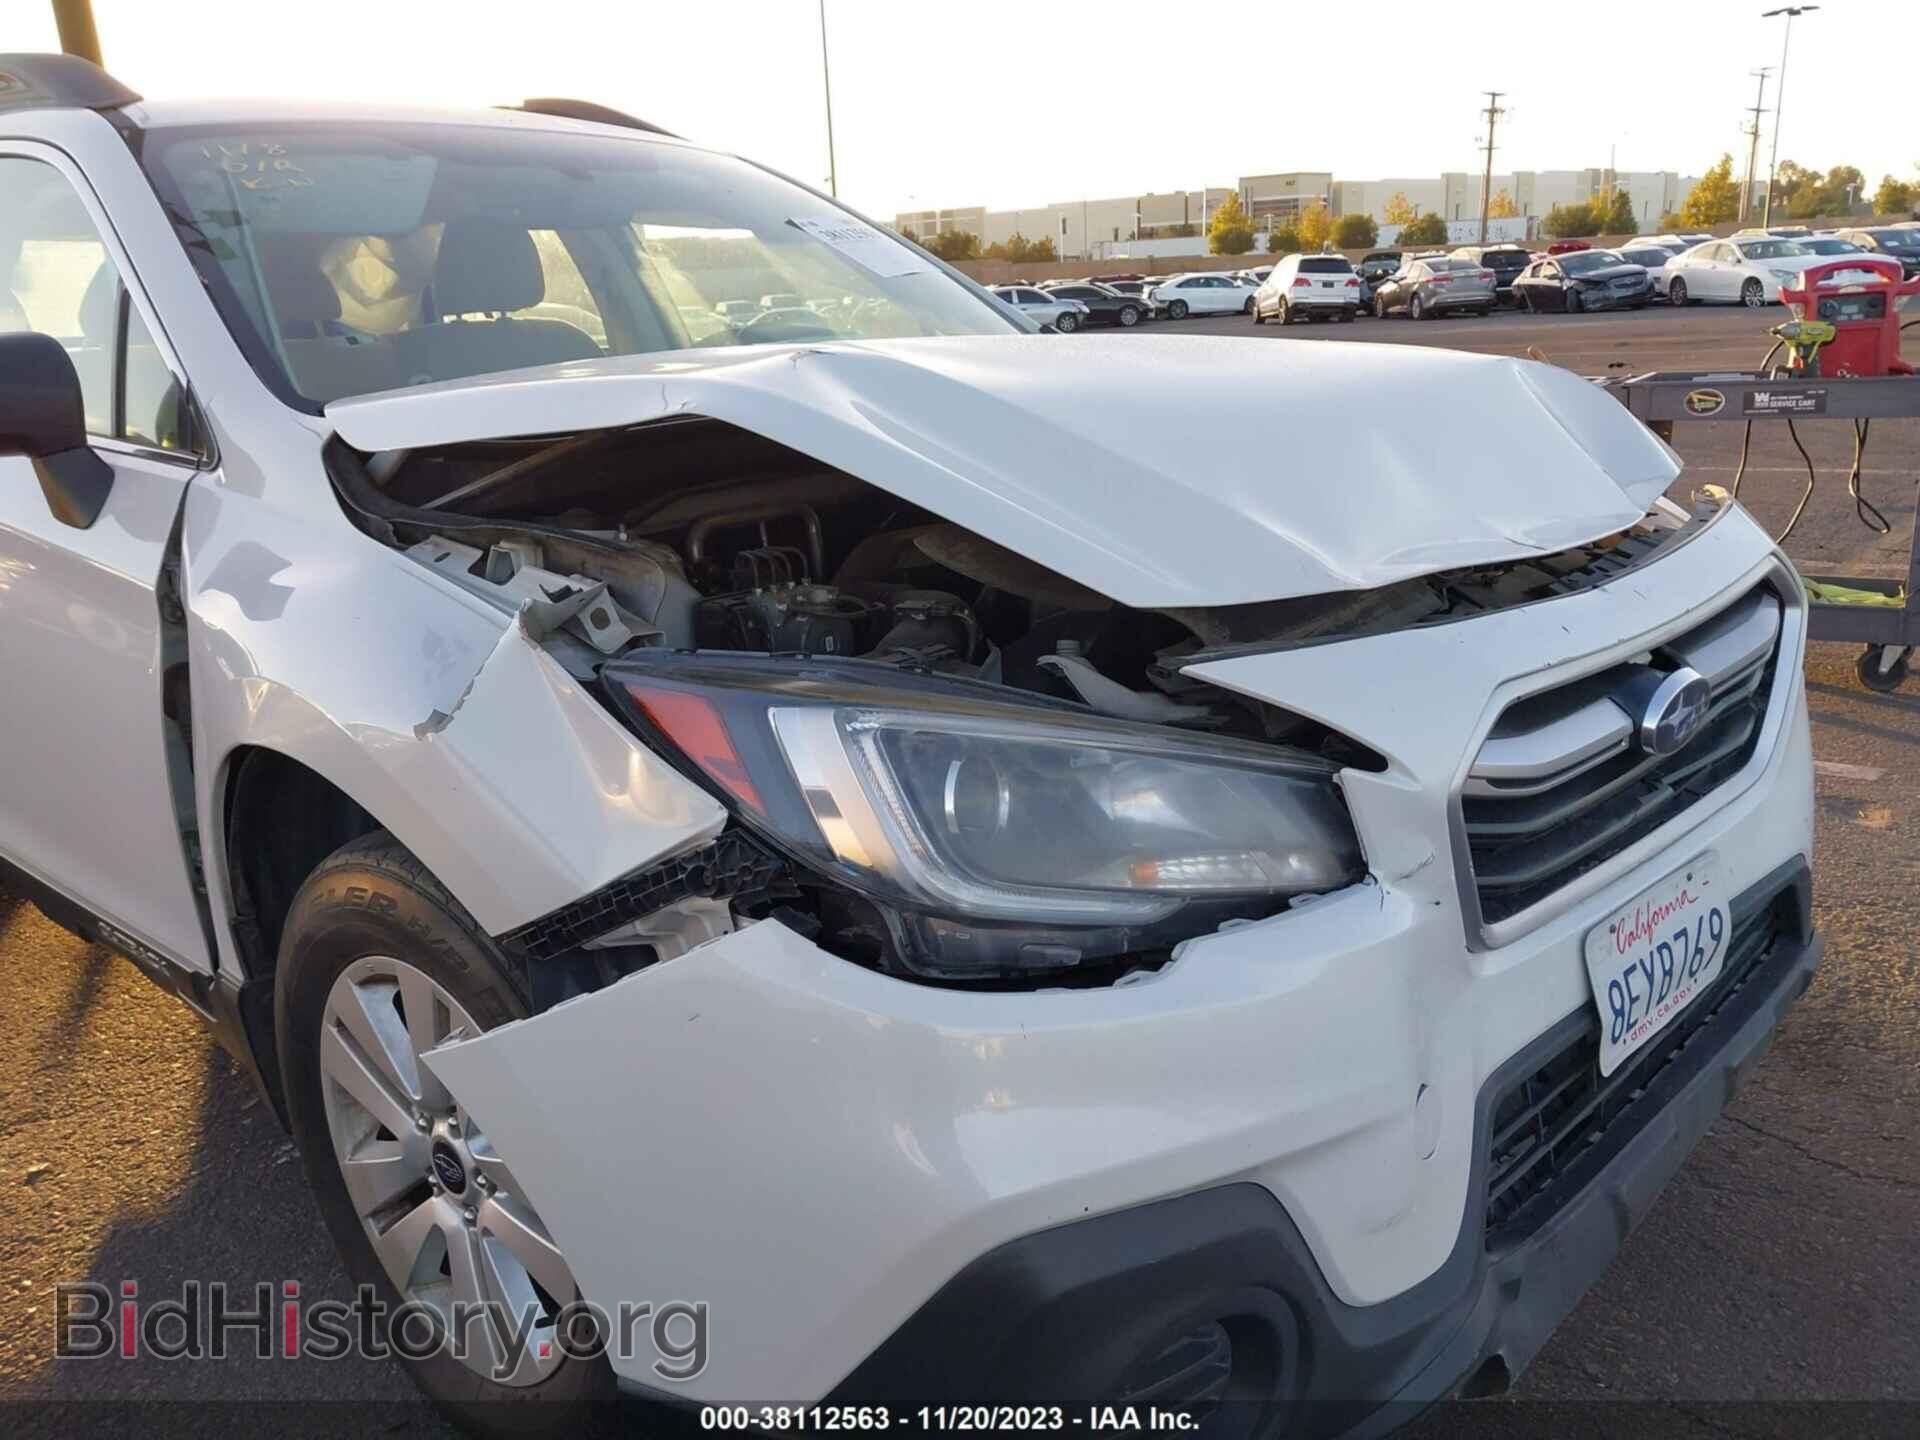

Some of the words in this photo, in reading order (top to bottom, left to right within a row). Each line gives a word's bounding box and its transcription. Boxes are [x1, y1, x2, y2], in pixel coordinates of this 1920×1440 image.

[1770, 400, 1797, 408] SERVICE
[1798, 399, 1816, 407] CART
[1614, 888, 1702, 956] California
[1607, 906, 1724, 1046] 8EYB769
